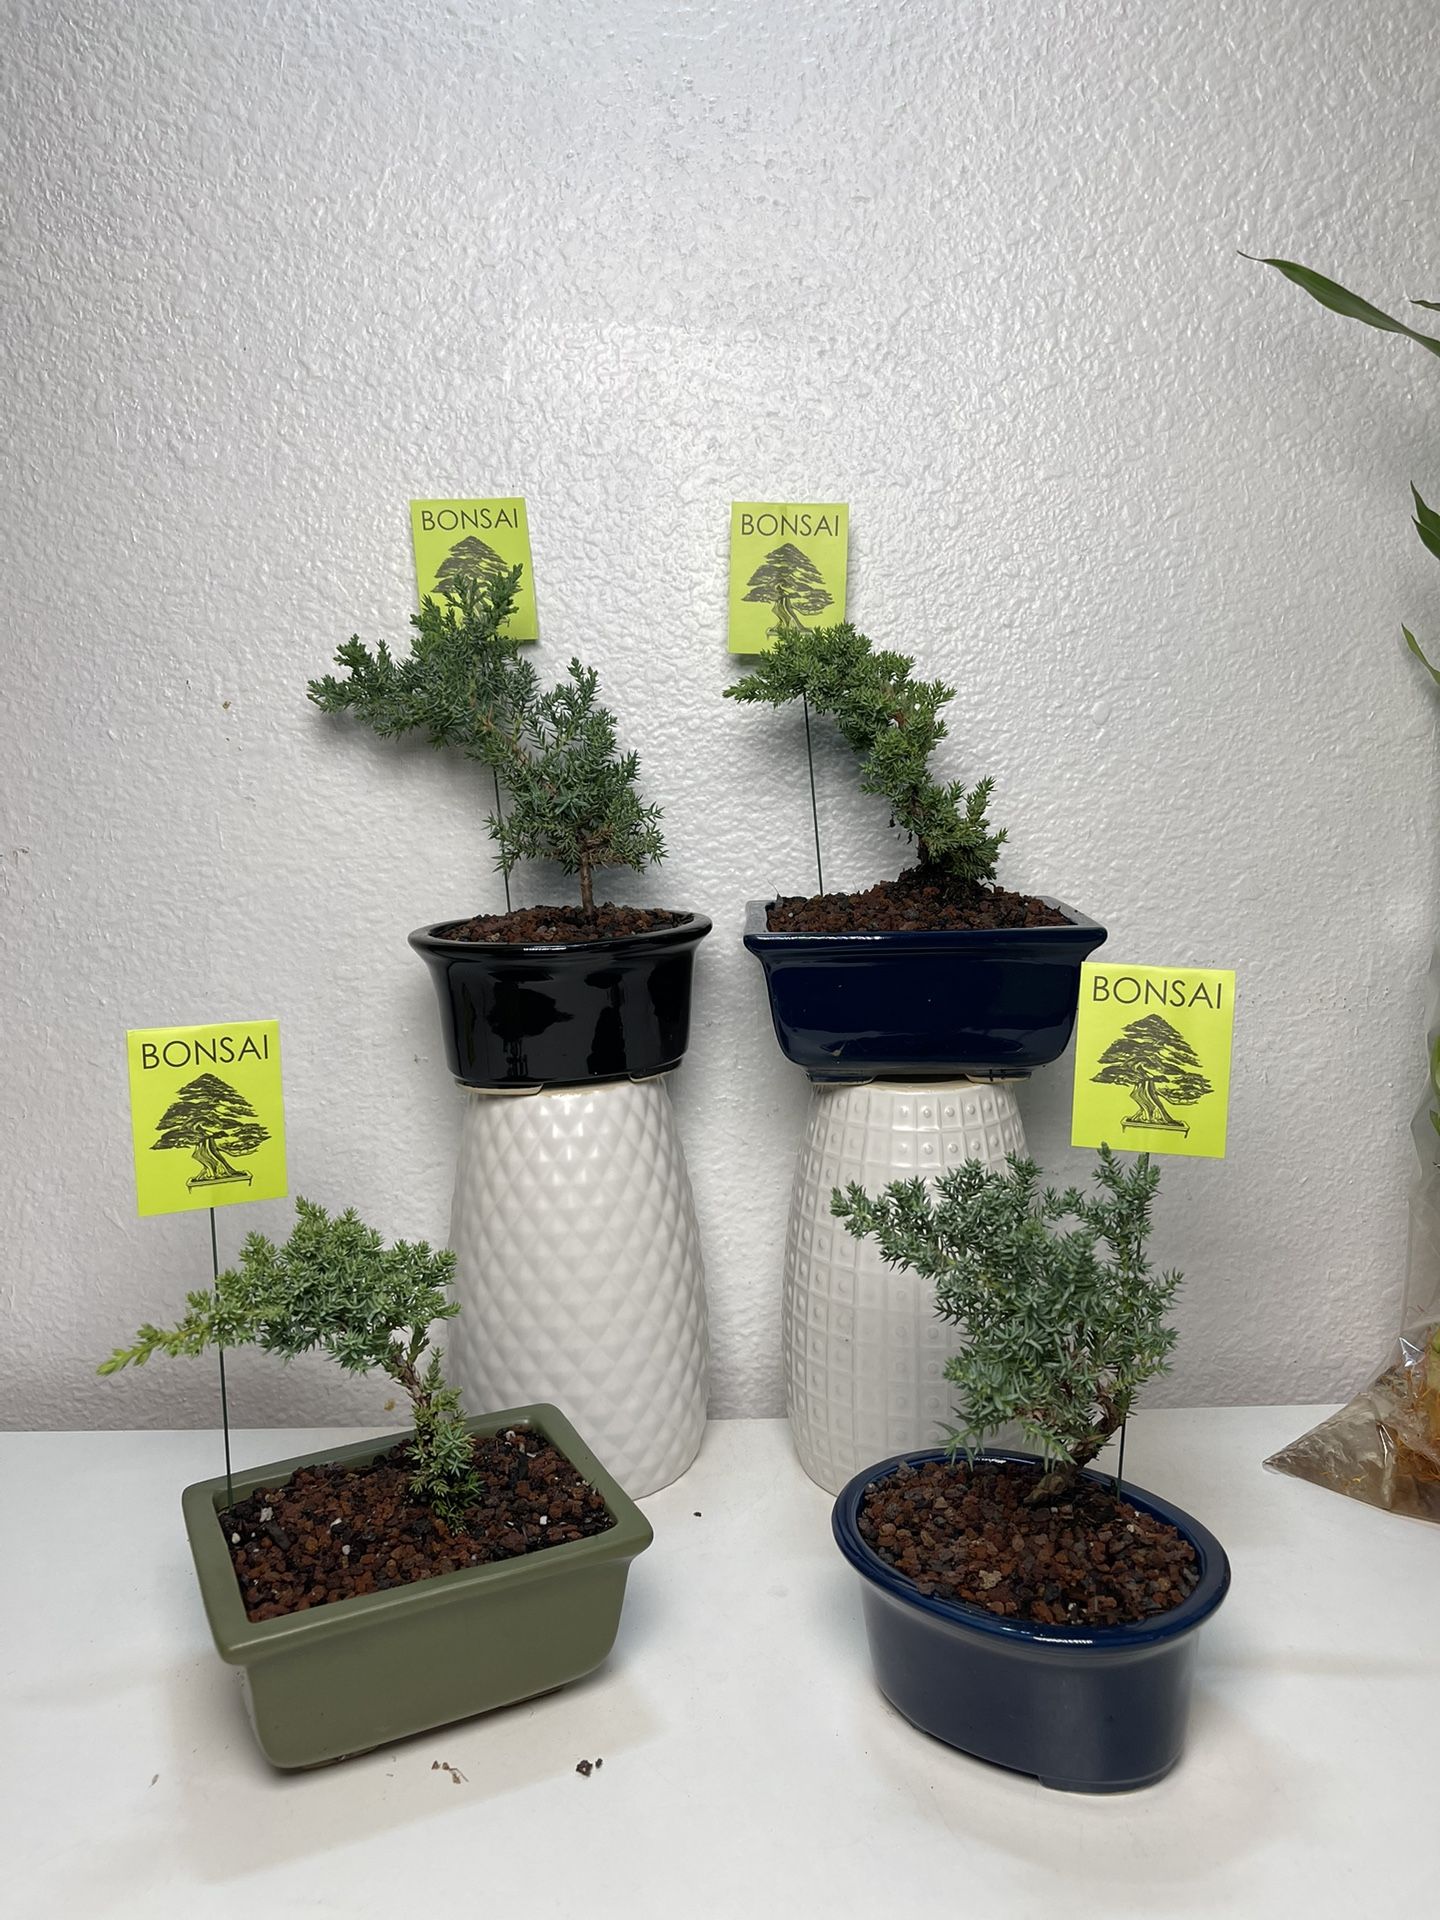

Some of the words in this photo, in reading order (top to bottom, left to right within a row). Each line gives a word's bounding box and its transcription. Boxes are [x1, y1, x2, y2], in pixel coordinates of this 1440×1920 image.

[422, 508, 518, 530] BONSAI
[742, 514, 838, 536] BONSAI
[1093, 976, 1221, 1009] BONSAI
[142, 1034, 268, 1069] BONSAI
